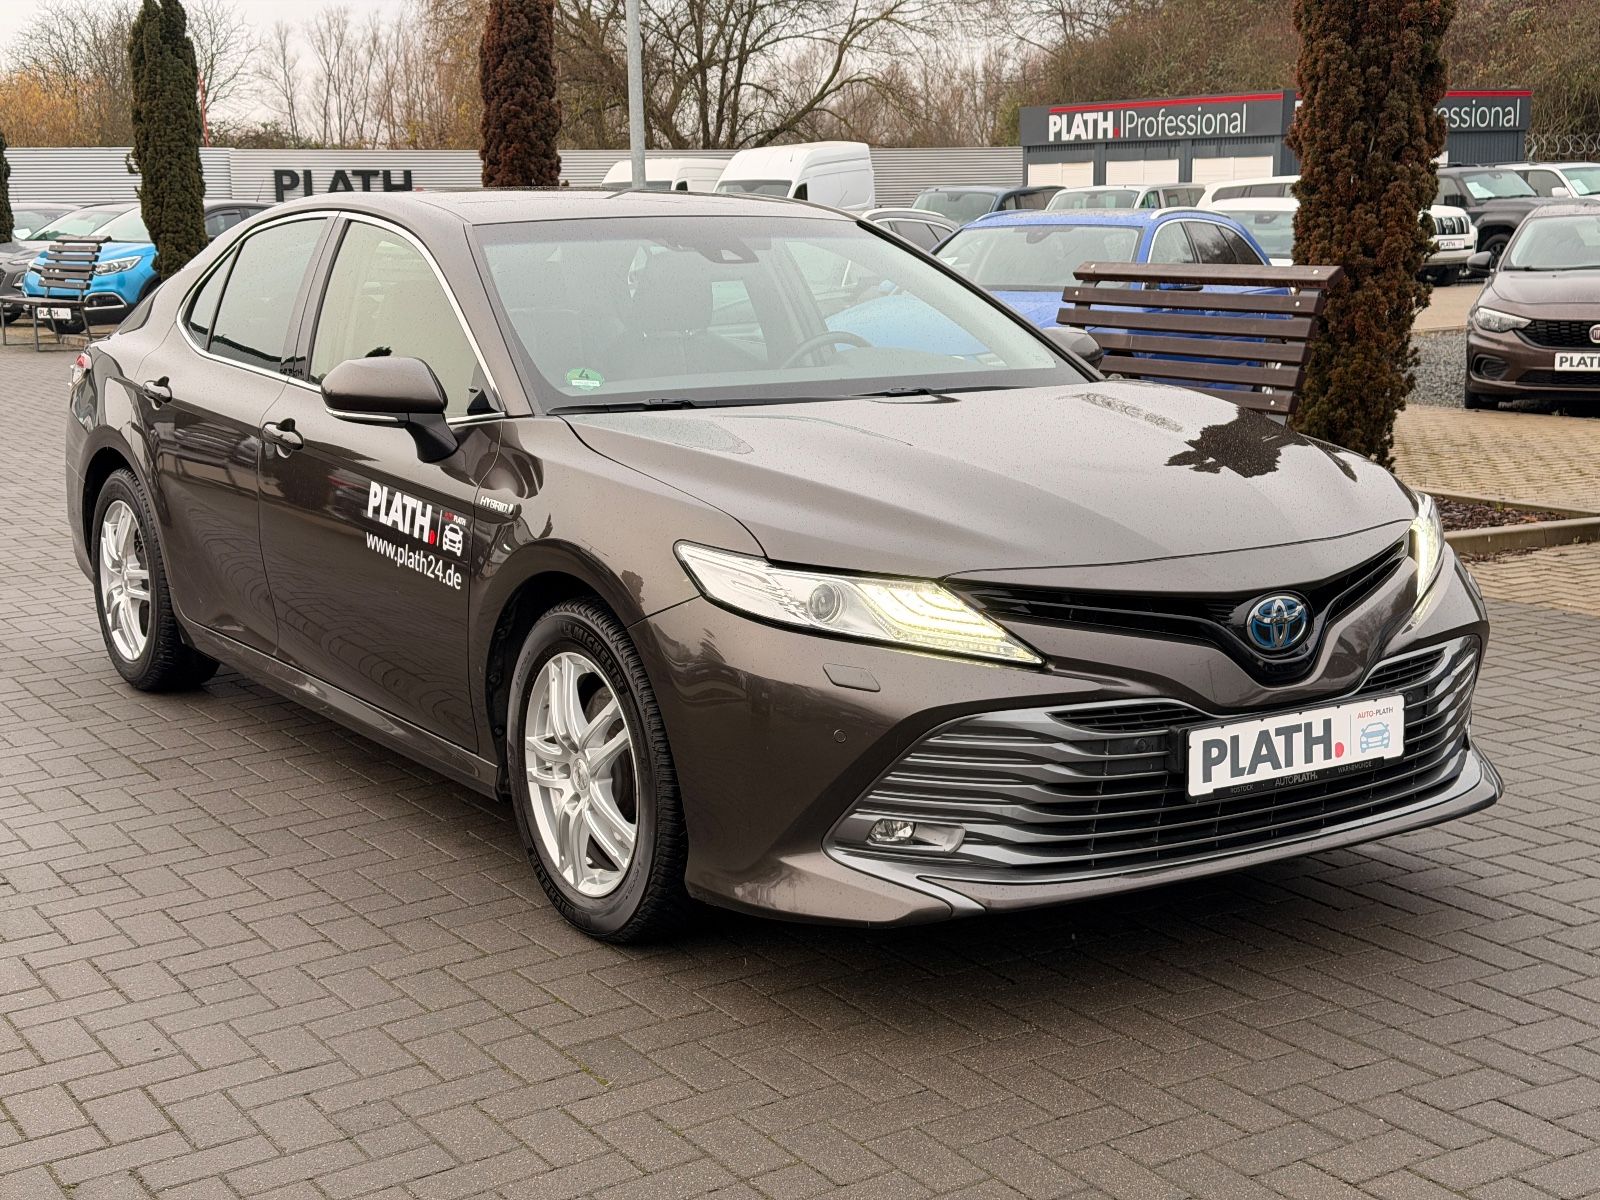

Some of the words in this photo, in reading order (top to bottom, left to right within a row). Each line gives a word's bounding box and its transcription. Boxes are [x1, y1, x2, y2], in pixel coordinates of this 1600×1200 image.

[1048, 110, 1119, 142] PLATH.
[1126, 103, 1247, 138] Professional
[1433, 98, 1521, 128] essional
[274, 169, 424, 202] PLATH
[367, 481, 436, 545] PLATH.
[480, 496, 508, 514] HYBRID
[366, 531, 462, 590] www.plath24.de
[1357, 706, 1394, 719] AUTO-PLATH
[1202, 718, 1345, 783] PLATH.
